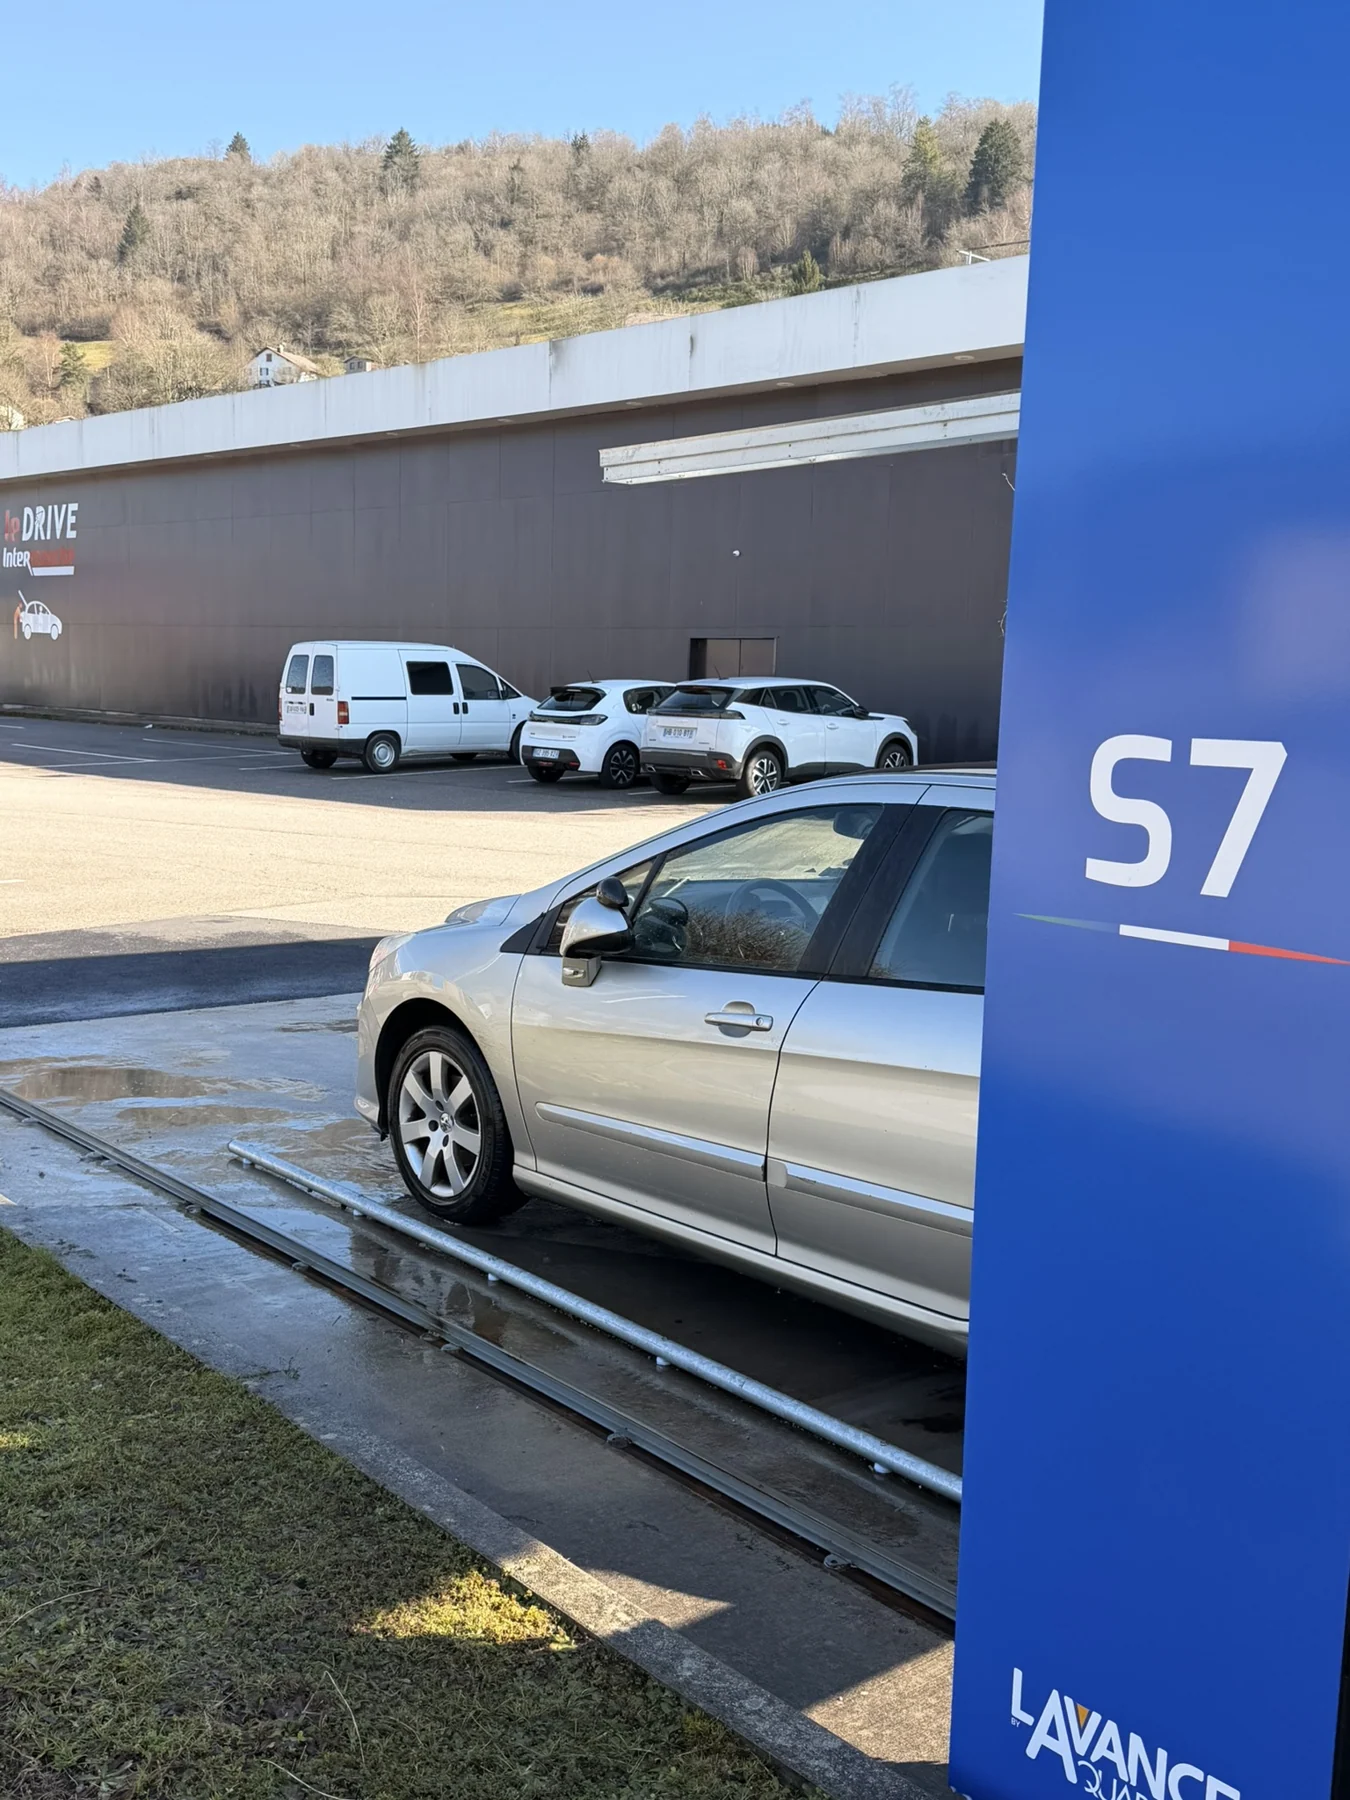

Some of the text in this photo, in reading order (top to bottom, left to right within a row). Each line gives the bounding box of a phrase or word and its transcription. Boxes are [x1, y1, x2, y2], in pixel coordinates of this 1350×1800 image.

[22, 503, 78, 541] DRIVE
[1085, 734, 1288, 898] S7
[1011, 1717, 1021, 1728] BY
